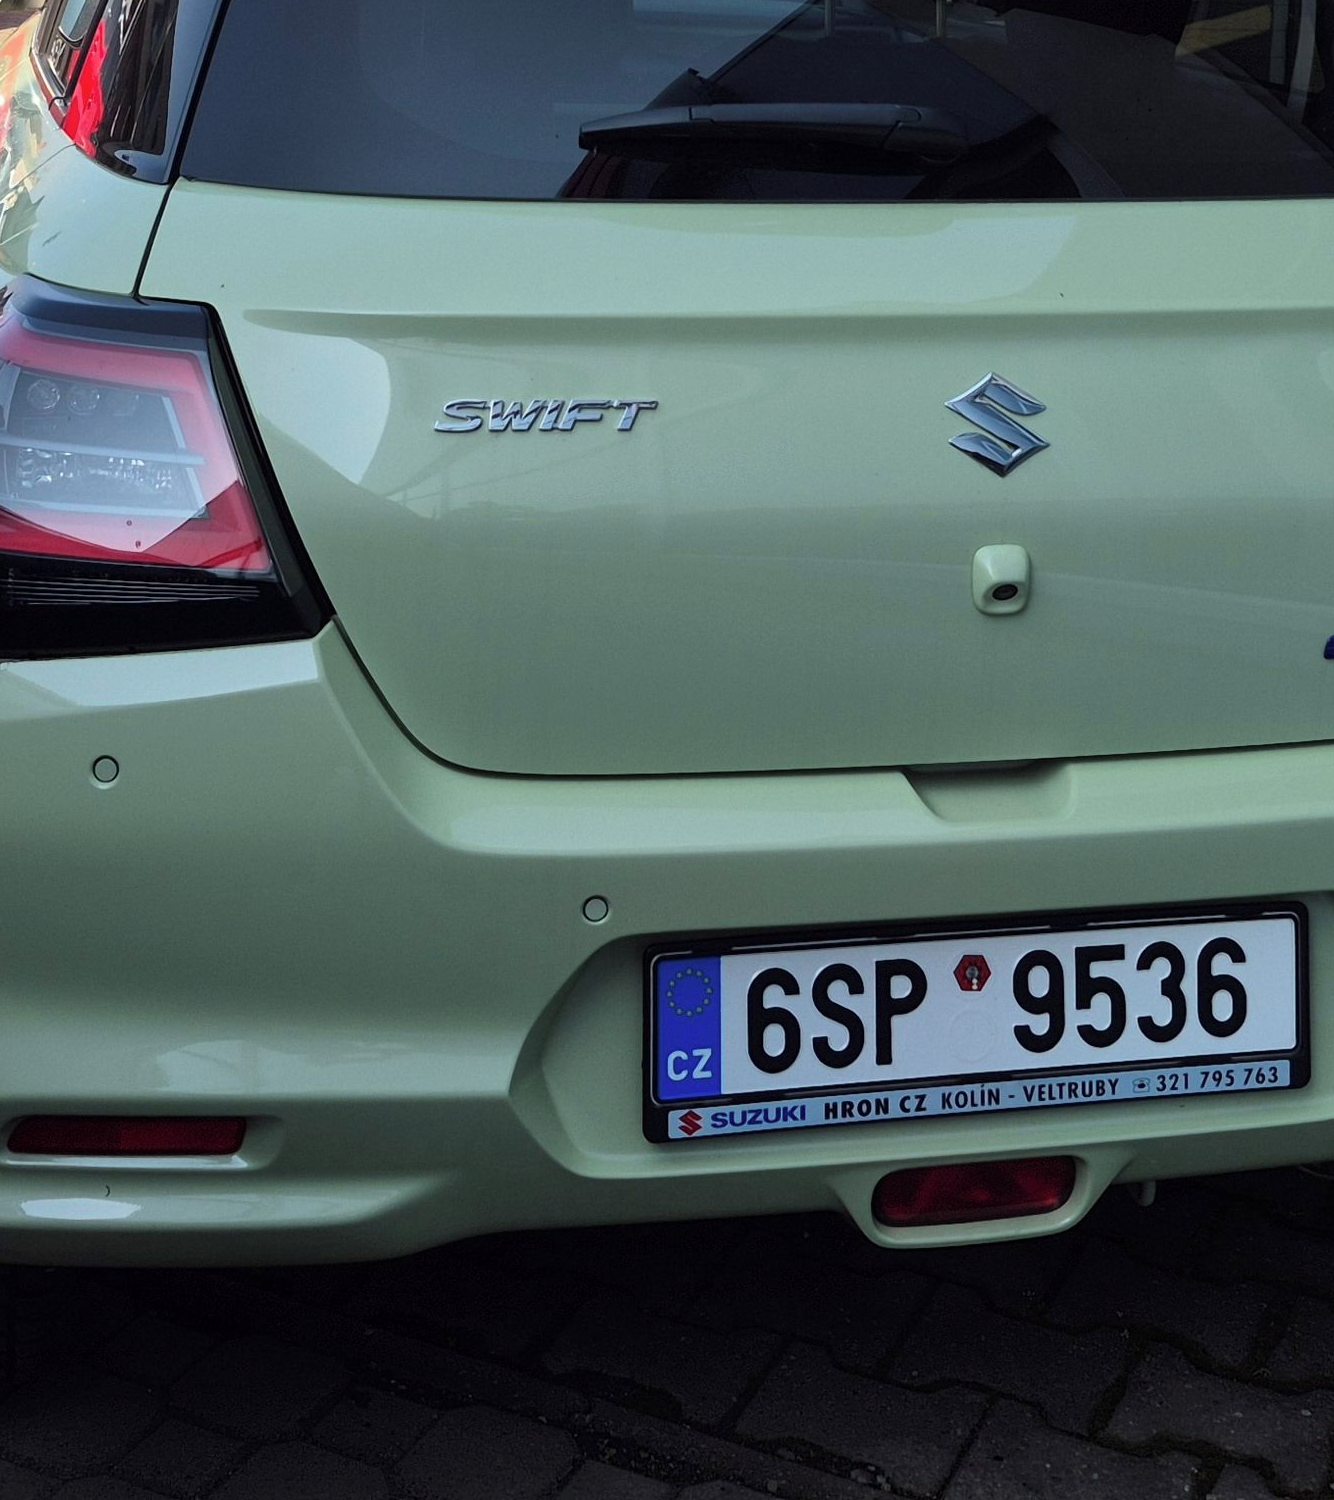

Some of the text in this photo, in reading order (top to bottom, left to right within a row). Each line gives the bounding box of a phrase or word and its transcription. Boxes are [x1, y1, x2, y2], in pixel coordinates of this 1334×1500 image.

[434, 399, 658, 432] SWIFT
[746, 936, 1247, 1074] 6SP 9536
[667, 1048, 713, 1082] CZ
[710, 1104, 806, 1129] SUZUKI
[824, 1097, 890, 1120] HRON
[899, 1093, 928, 1113] CZ
[941, 1083, 1001, 1110] KOLÍN
[1022, 1078, 1119, 1102] VELTRUBY
[1155, 1072, 1189, 1092] 321
[1199, 1069, 1235, 1089] 795
[1243, 1065, 1279, 1085] 763
